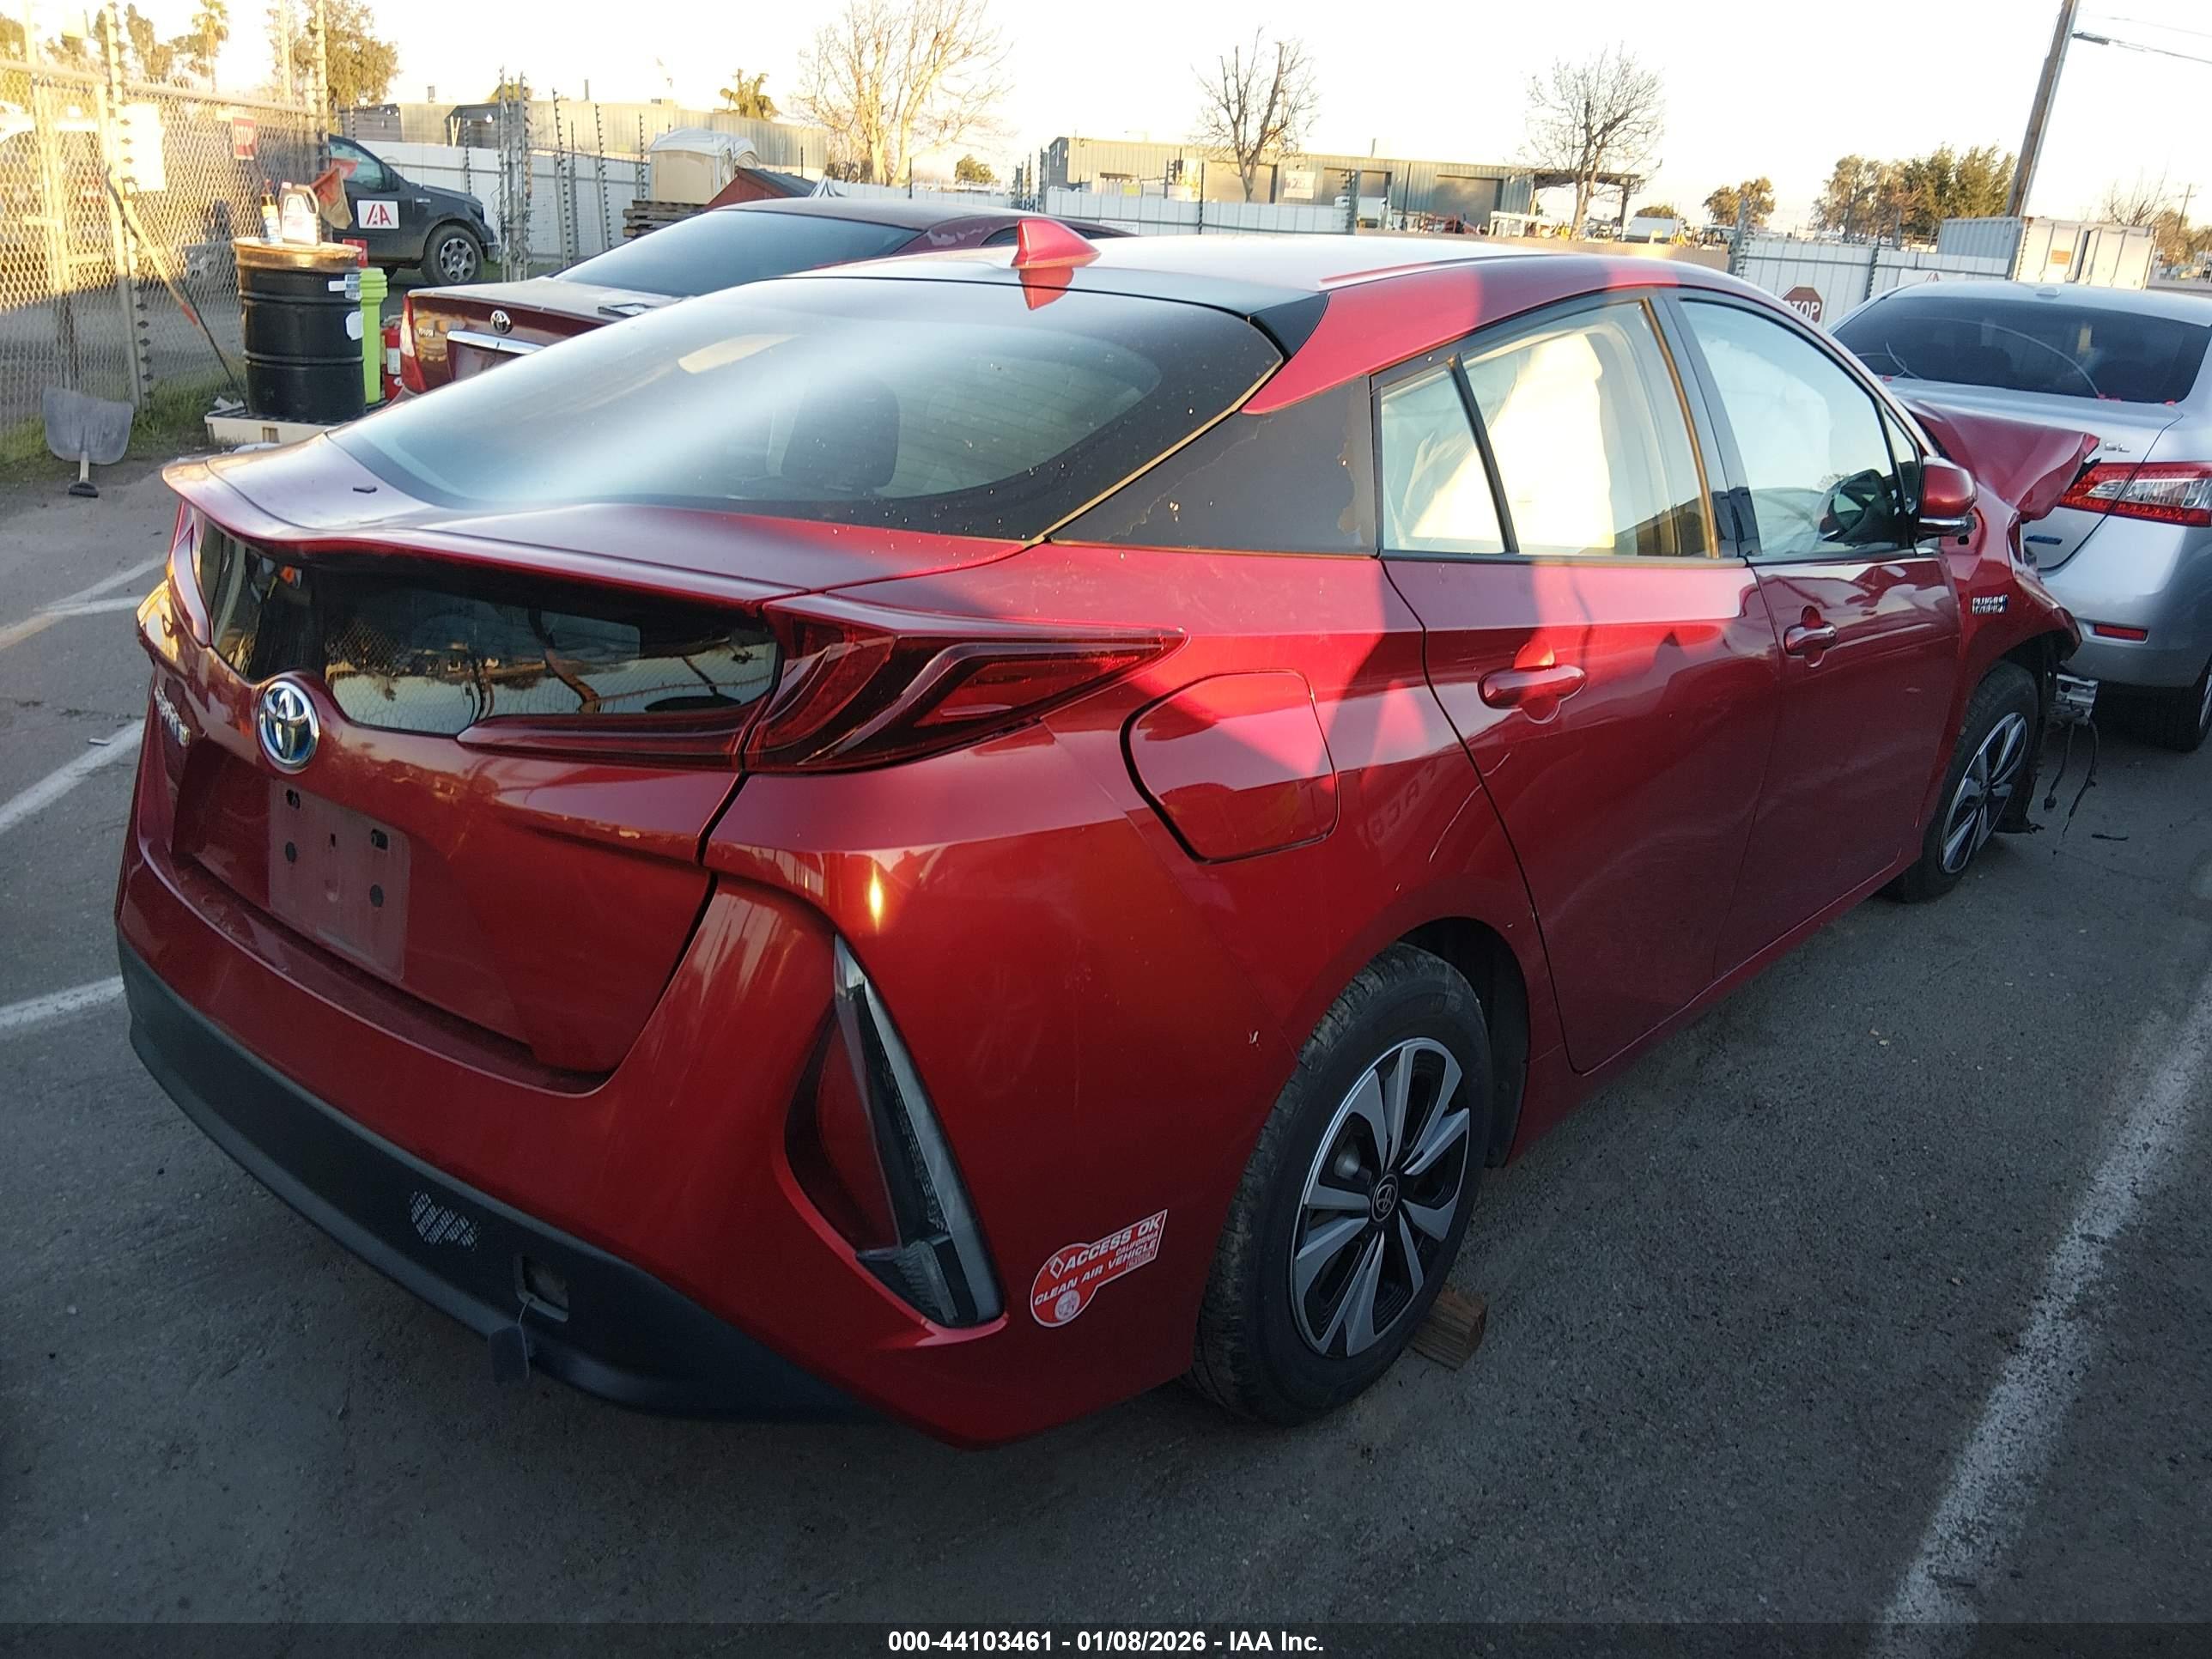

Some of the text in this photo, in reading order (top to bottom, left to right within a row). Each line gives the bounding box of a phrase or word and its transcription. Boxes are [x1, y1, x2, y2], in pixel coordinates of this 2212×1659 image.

[234, 125, 255, 145] STOP
[1063, 1229, 1133, 1273] ACCESS
[1137, 1214, 1163, 1237] OK
[1116, 1230, 1158, 1255] CALIFORNIA
[1035, 1277, 1078, 1306] CLEAN
[1081, 1265, 1103, 1283] AIR
[1108, 1238, 1158, 1270] VEHICLE
